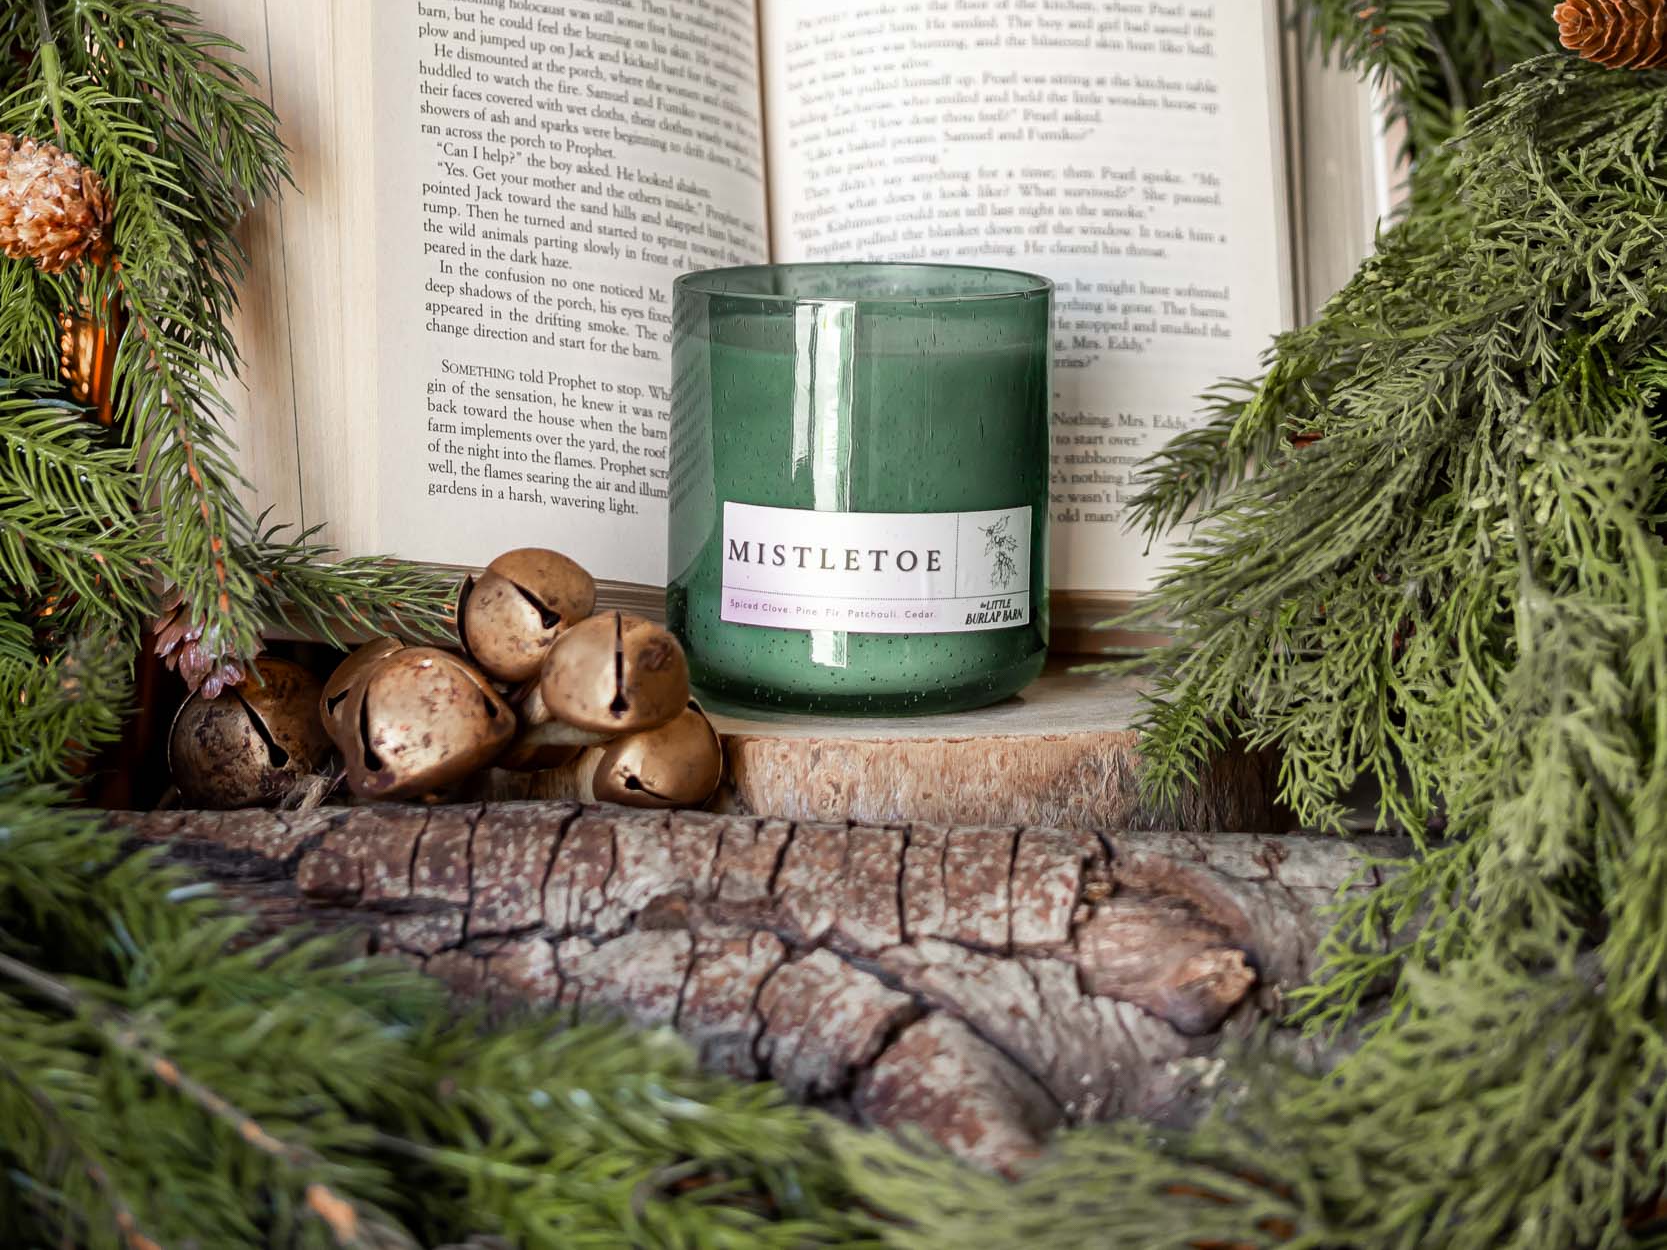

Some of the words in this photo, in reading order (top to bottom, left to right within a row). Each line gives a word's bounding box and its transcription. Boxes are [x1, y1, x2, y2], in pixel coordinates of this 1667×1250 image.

[417, 1, 450, 21] barn,
[454, 6, 475, 23] but
[479, 9, 495, 25] he
[498, 15, 533, 31] could
[434, 42, 453, 58] He
[456, 46, 528, 68] dismounted
[418, 59, 472, 80] huddled
[476, 71, 489, 82] to
[492, 73, 530, 88] watch
[420, 123, 440, 135] ran
[445, 127, 482, 140] across
[486, 127, 506, 143] the
[510, 133, 546, 149] porch
[472, 145, 478, 159] I
[472, 165, 496, 181] Get
[500, 173, 528, 186] your
[424, 242, 466, 256] peared
[470, 243, 482, 258] in
[486, 245, 506, 261] the
[509, 248, 537, 265] dark
[541, 251, 572, 269] haze.
[439, 259, 453, 274] In
[458, 261, 479, 277] the
[484, 267, 545, 285] confusion
[551, 277, 567, 288] no
[572, 280, 595, 292] one
[599, 284, 644, 299] noticed
[424, 278, 454, 297] deep
[459, 281, 512, 301] shadows
[516, 288, 528, 303] of
[533, 290, 552, 306] the
[556, 296, 596, 313] porch,
[600, 298, 617, 314] his
[620, 307, 644, 319] eyes
[425, 302, 483, 317] appeared
[490, 305, 502, 319] in
[508, 307, 528, 323] the
[535, 310, 582, 332] drifting
[587, 319, 629, 335] smoke.
[634, 323, 658, 340] The
[425, 317, 469, 338] change
[473, 322, 528, 342] direction
[532, 331, 555, 346] and
[559, 337, 585, 349] start
[589, 336, 607, 352] for
[610, 340, 629, 355] the
[441, 359, 514, 380] SOMETHING
[519, 368, 544, 384] told
[548, 371, 596, 390] Prophet
[600, 381, 613, 392] to
[616, 384, 644, 399] stop.
[426, 378, 446, 394] gin
[451, 380, 464, 395] of
[470, 381, 490, 397] the
[495, 389, 556, 406] sensation,
[561, 392, 576, 408] he
[581, 395, 614, 411] knew
[618, 400, 627, 414] it
[631, 406, 653, 417] was
[427, 397, 457, 414] back
[463, 405, 507, 419] toward
[513, 406, 533, 422] the
[538, 409, 574, 427] house
[579, 415, 613, 431] when
[618, 419, 636, 435] the
[641, 422, 667, 439] barn
[427, 418, 456, 434] farm
[460, 421, 532, 442] implements
[535, 434, 562, 445] over
[566, 432, 585, 448] the
[588, 438, 618, 454] yard,
[622, 440, 640, 455] the
[643, 447, 665, 458] roof
[427, 438, 440, 452] of
[444, 439, 464, 454] the
[467, 443, 499, 460] night
[503, 446, 528, 461] into
[530, 448, 550, 464] the
[554, 450, 596, 469] flames.
[600, 456, 646, 476] Prophet
[428, 459, 456, 476] well,
[460, 461, 480, 477] the
[484, 463, 523, 481] flames
[526, 471, 570, 489] searing
[572, 473, 592, 488] the
[595, 477, 611, 491] air
[614, 480, 636, 494] and
[428, 479, 477, 496] gardens
[481, 483, 493, 498] in
[497, 489, 504, 499] a
[508, 486, 546, 505] harsh,
[550, 495, 605, 513] wavering
[608, 498, 638, 515] light.
[728, 538, 941, 572] MISTLETOE
[729, 599, 758, 610] Spiced
[965, 610, 1001, 625] BURLAP
[1002, 607, 1024, 622] BARN
[987, 598, 1012, 610] LITTLE
